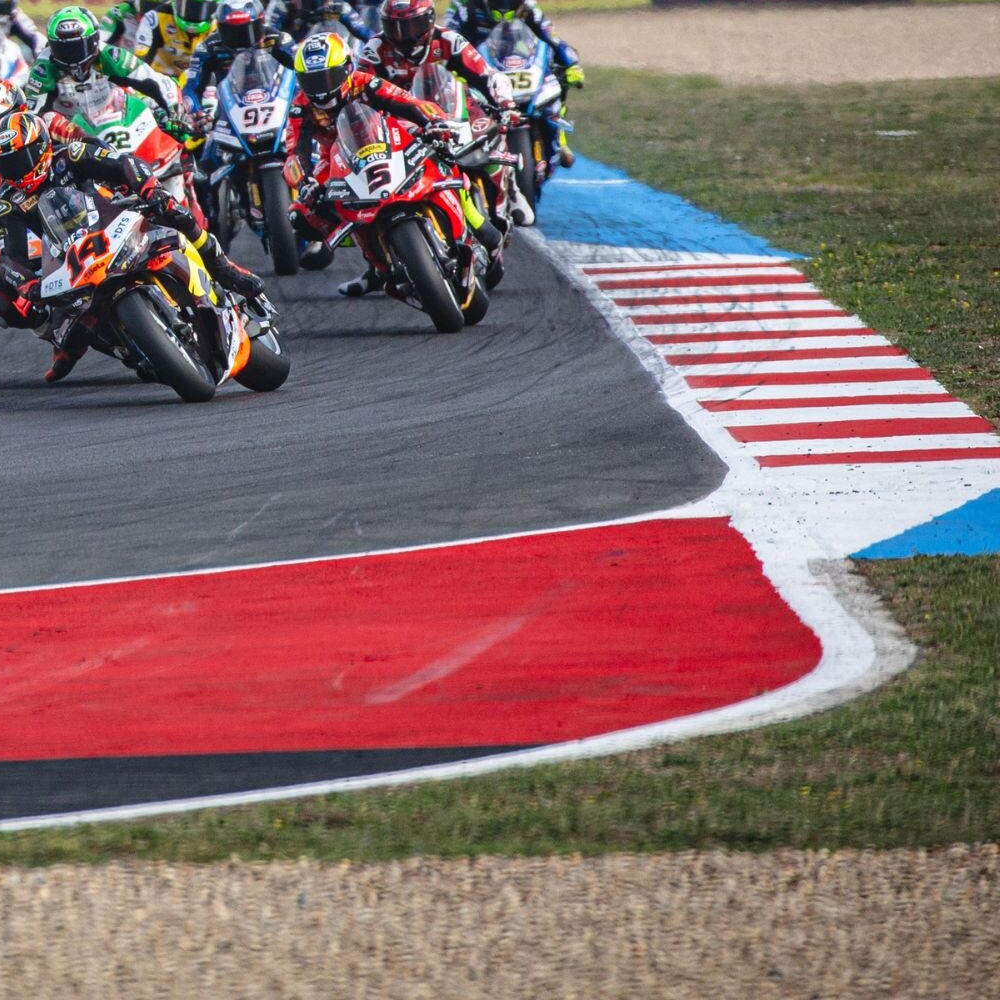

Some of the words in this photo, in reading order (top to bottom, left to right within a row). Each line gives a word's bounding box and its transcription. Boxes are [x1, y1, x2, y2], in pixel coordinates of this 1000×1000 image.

[244, 105, 275, 128] 97
[104, 131, 131, 149] 22
[365, 162, 392, 195] 5
[114, 217, 130, 235] DTS
[66, 229, 111, 289] 14
[49, 279, 63, 290] DTS
